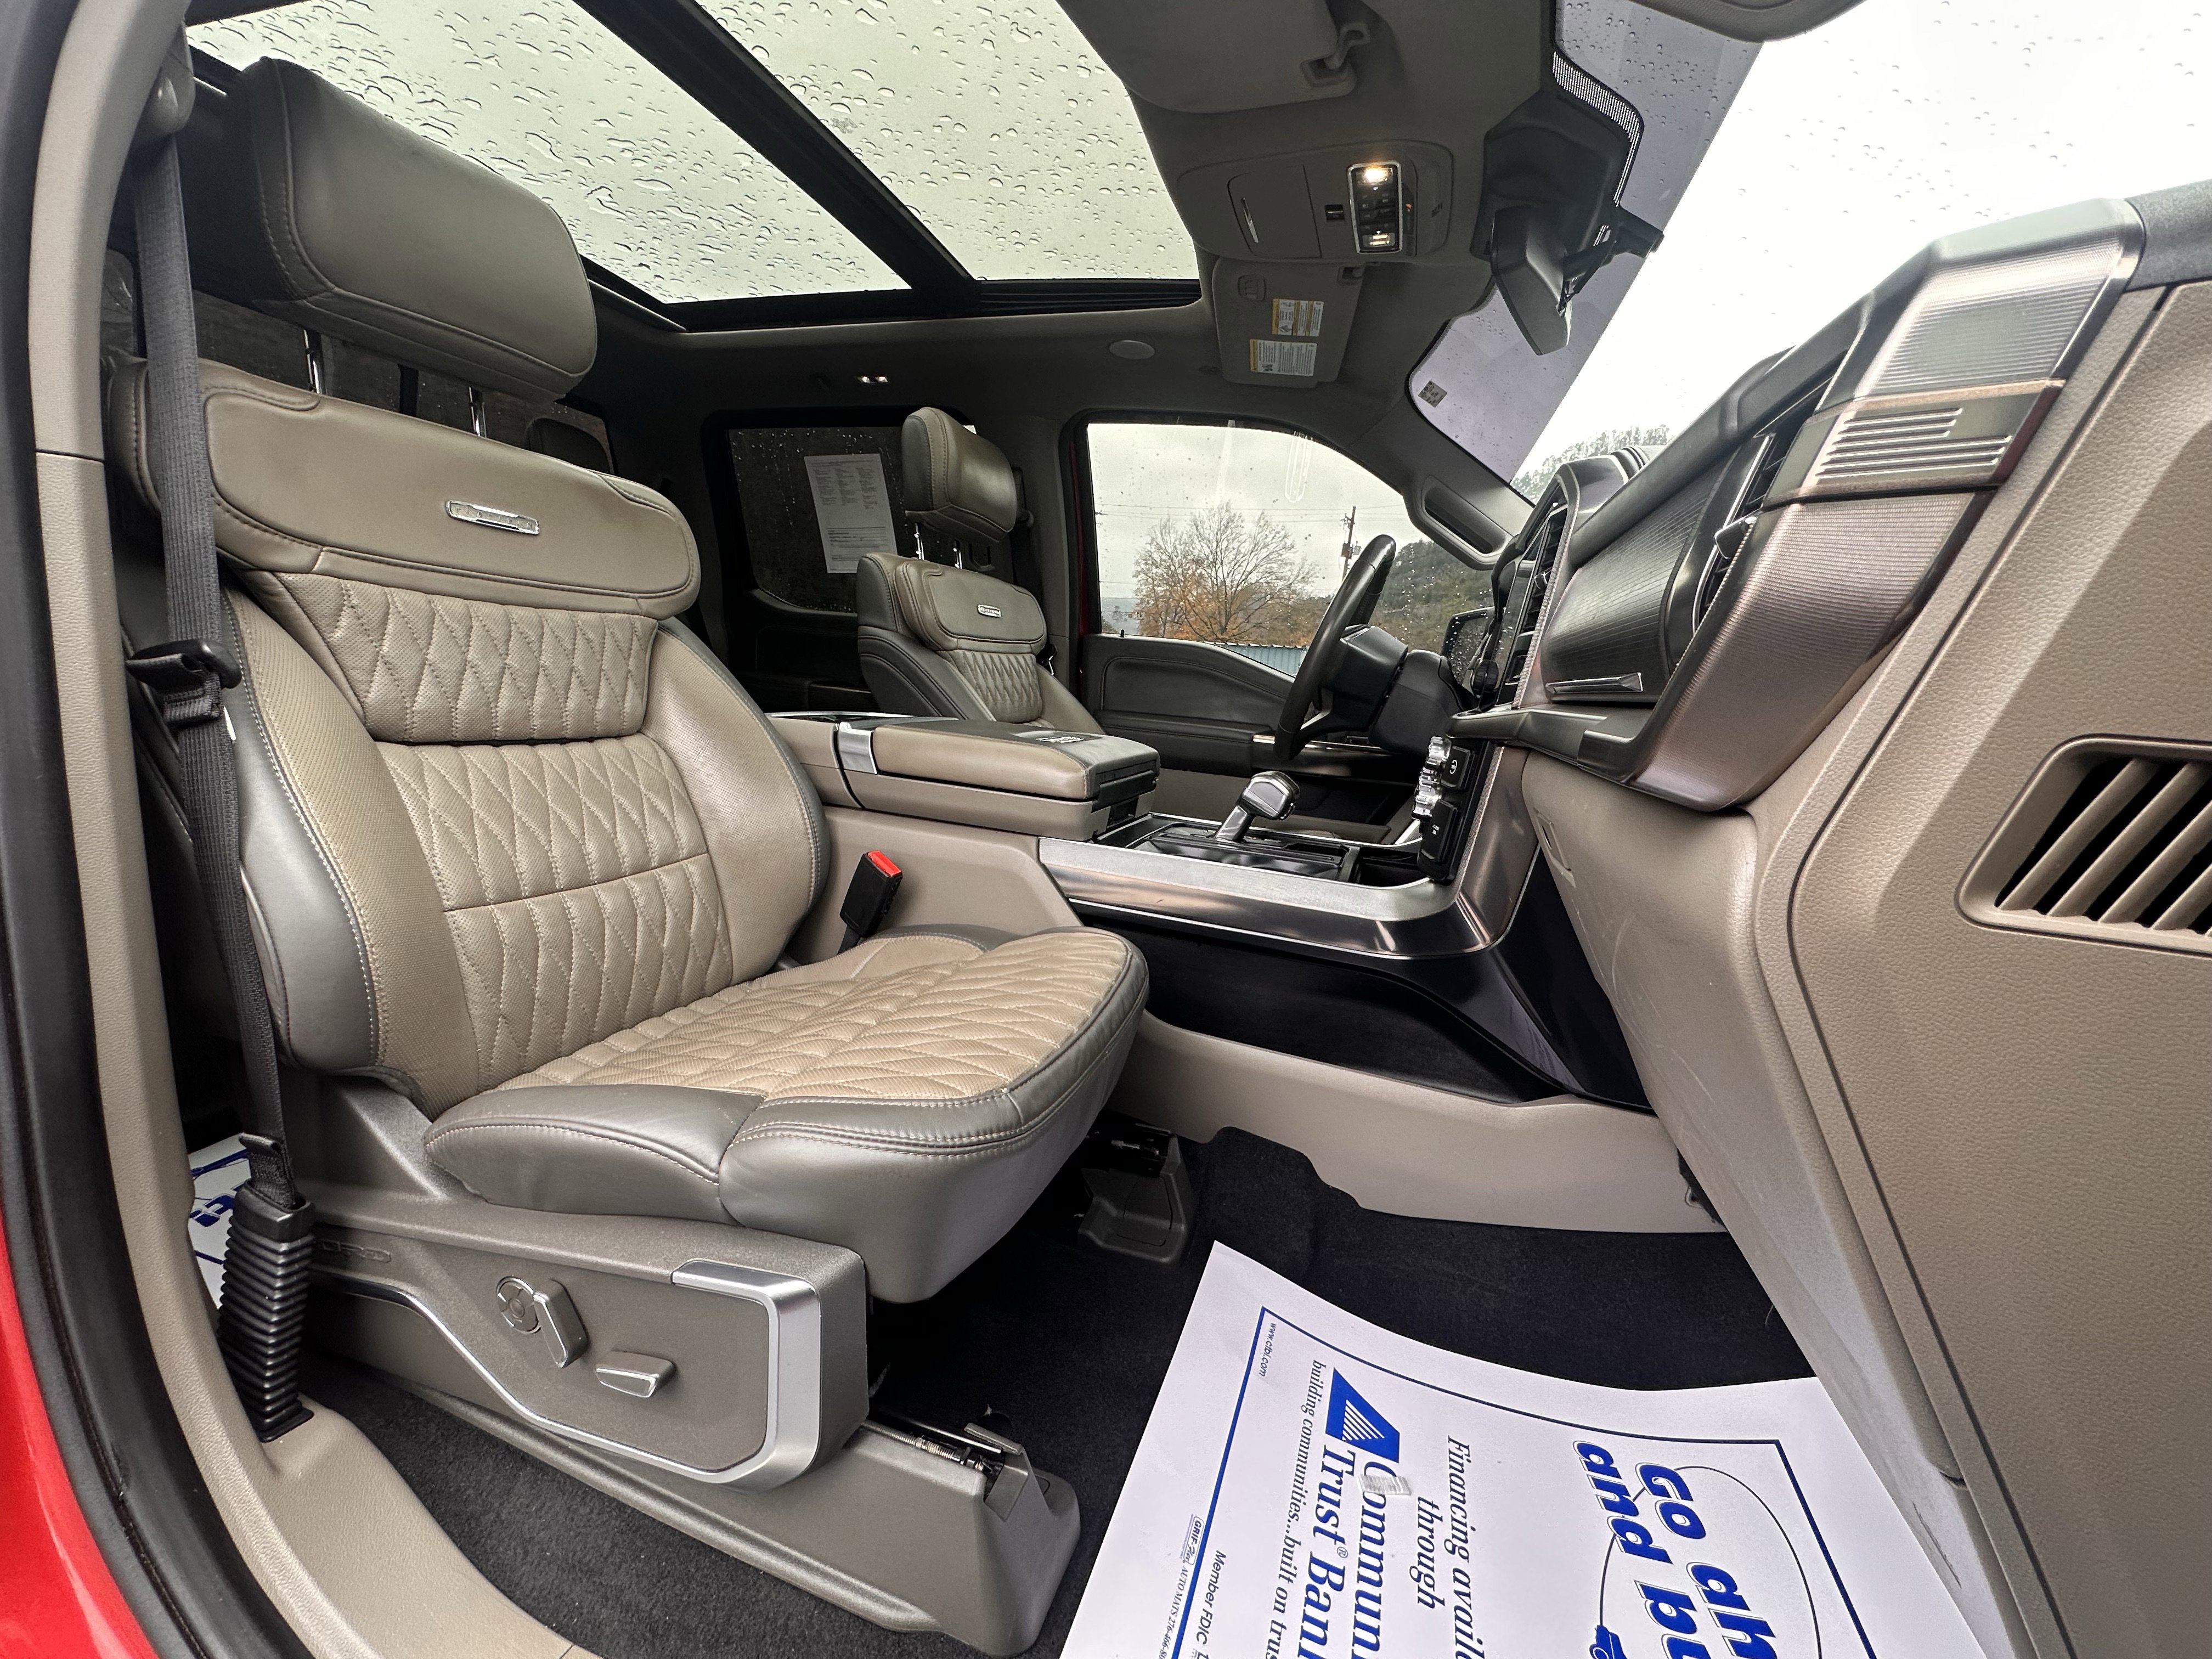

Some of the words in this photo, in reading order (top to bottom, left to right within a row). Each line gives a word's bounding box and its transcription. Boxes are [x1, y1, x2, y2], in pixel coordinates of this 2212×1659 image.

[1301, 1359, 1327, 1417] building
[1444, 1435, 1476, 1563] Financing
[1572, 1440, 1673, 1564] and
[1635, 1462, 1706, 1539] Go
[1178, 1566, 1189, 1591] AUTO
[1205, 1549, 1227, 1609] Member
[1351, 1462, 1397, 1659] Commun
[1409, 1496, 1446, 1610] through
[1170, 1590, 1183, 1617] MATS
[1196, 1608, 1213, 1645] FDIC
[1273, 1587, 1288, 1614] on
